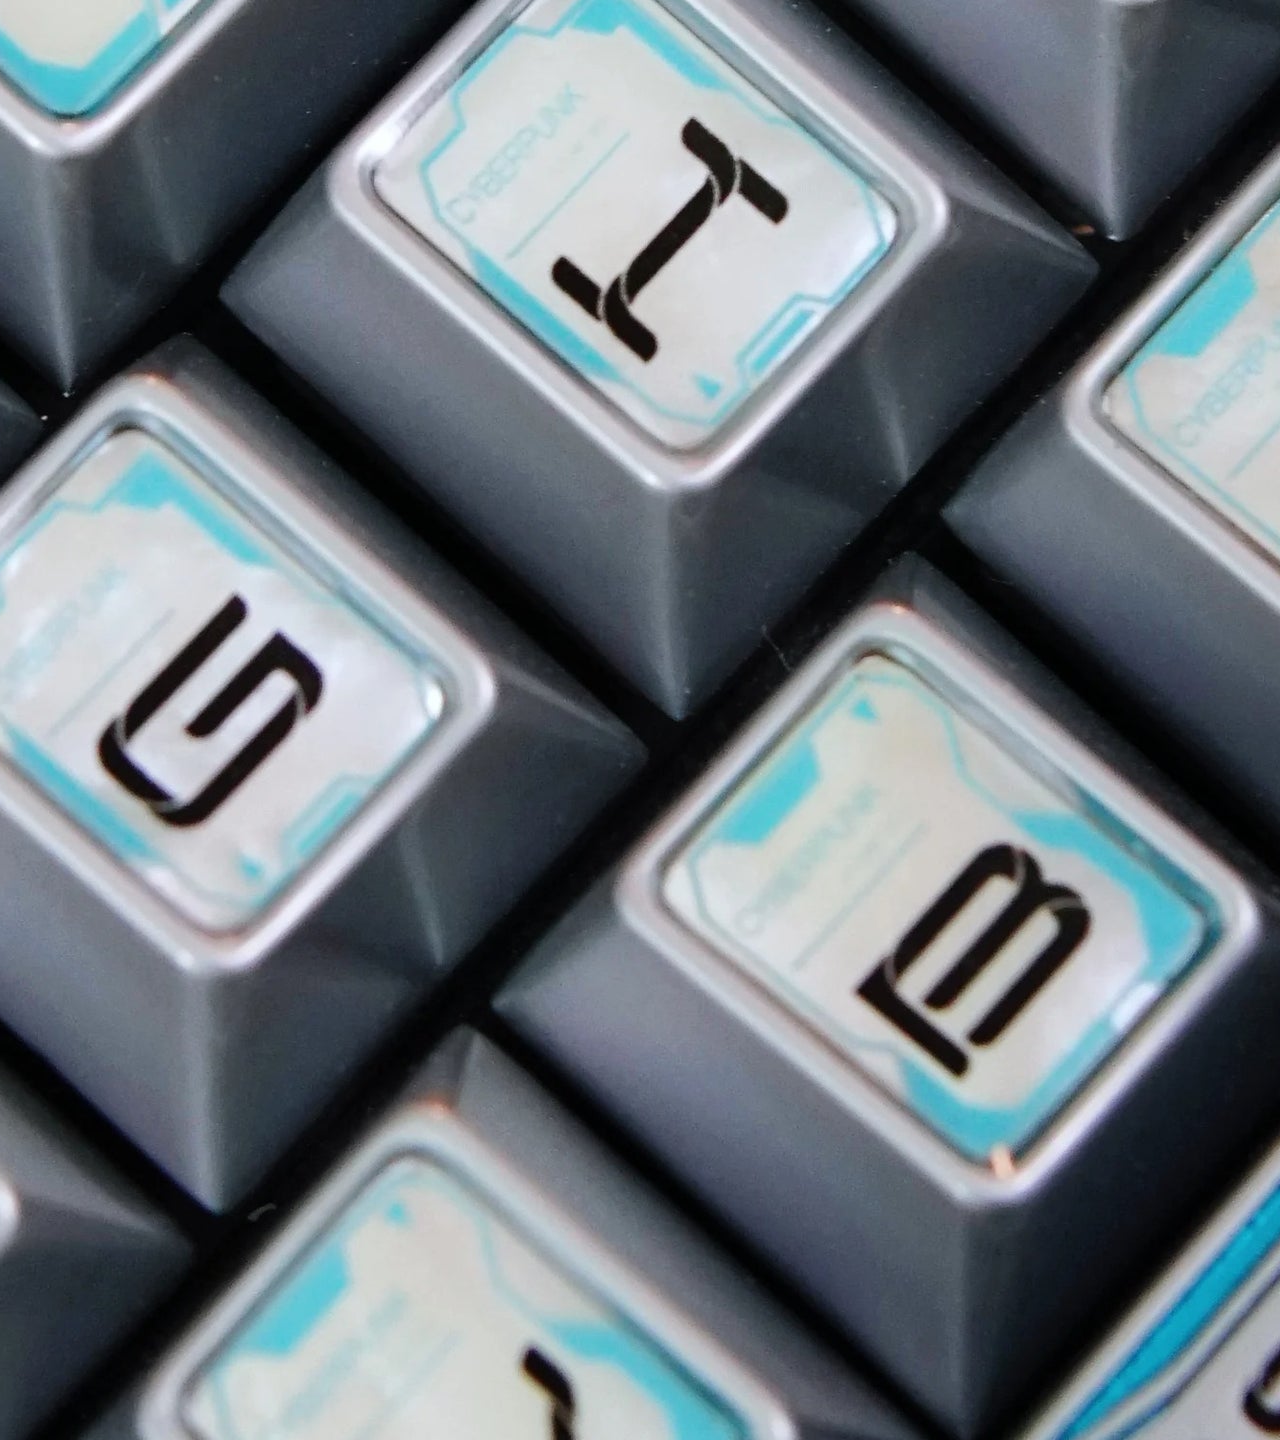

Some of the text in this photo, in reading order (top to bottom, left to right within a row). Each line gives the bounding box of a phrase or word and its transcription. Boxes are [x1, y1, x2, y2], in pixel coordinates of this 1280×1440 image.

[551, 115, 790, 364] H
[96, 590, 326, 829] G
[854, 840, 1093, 1079] B
